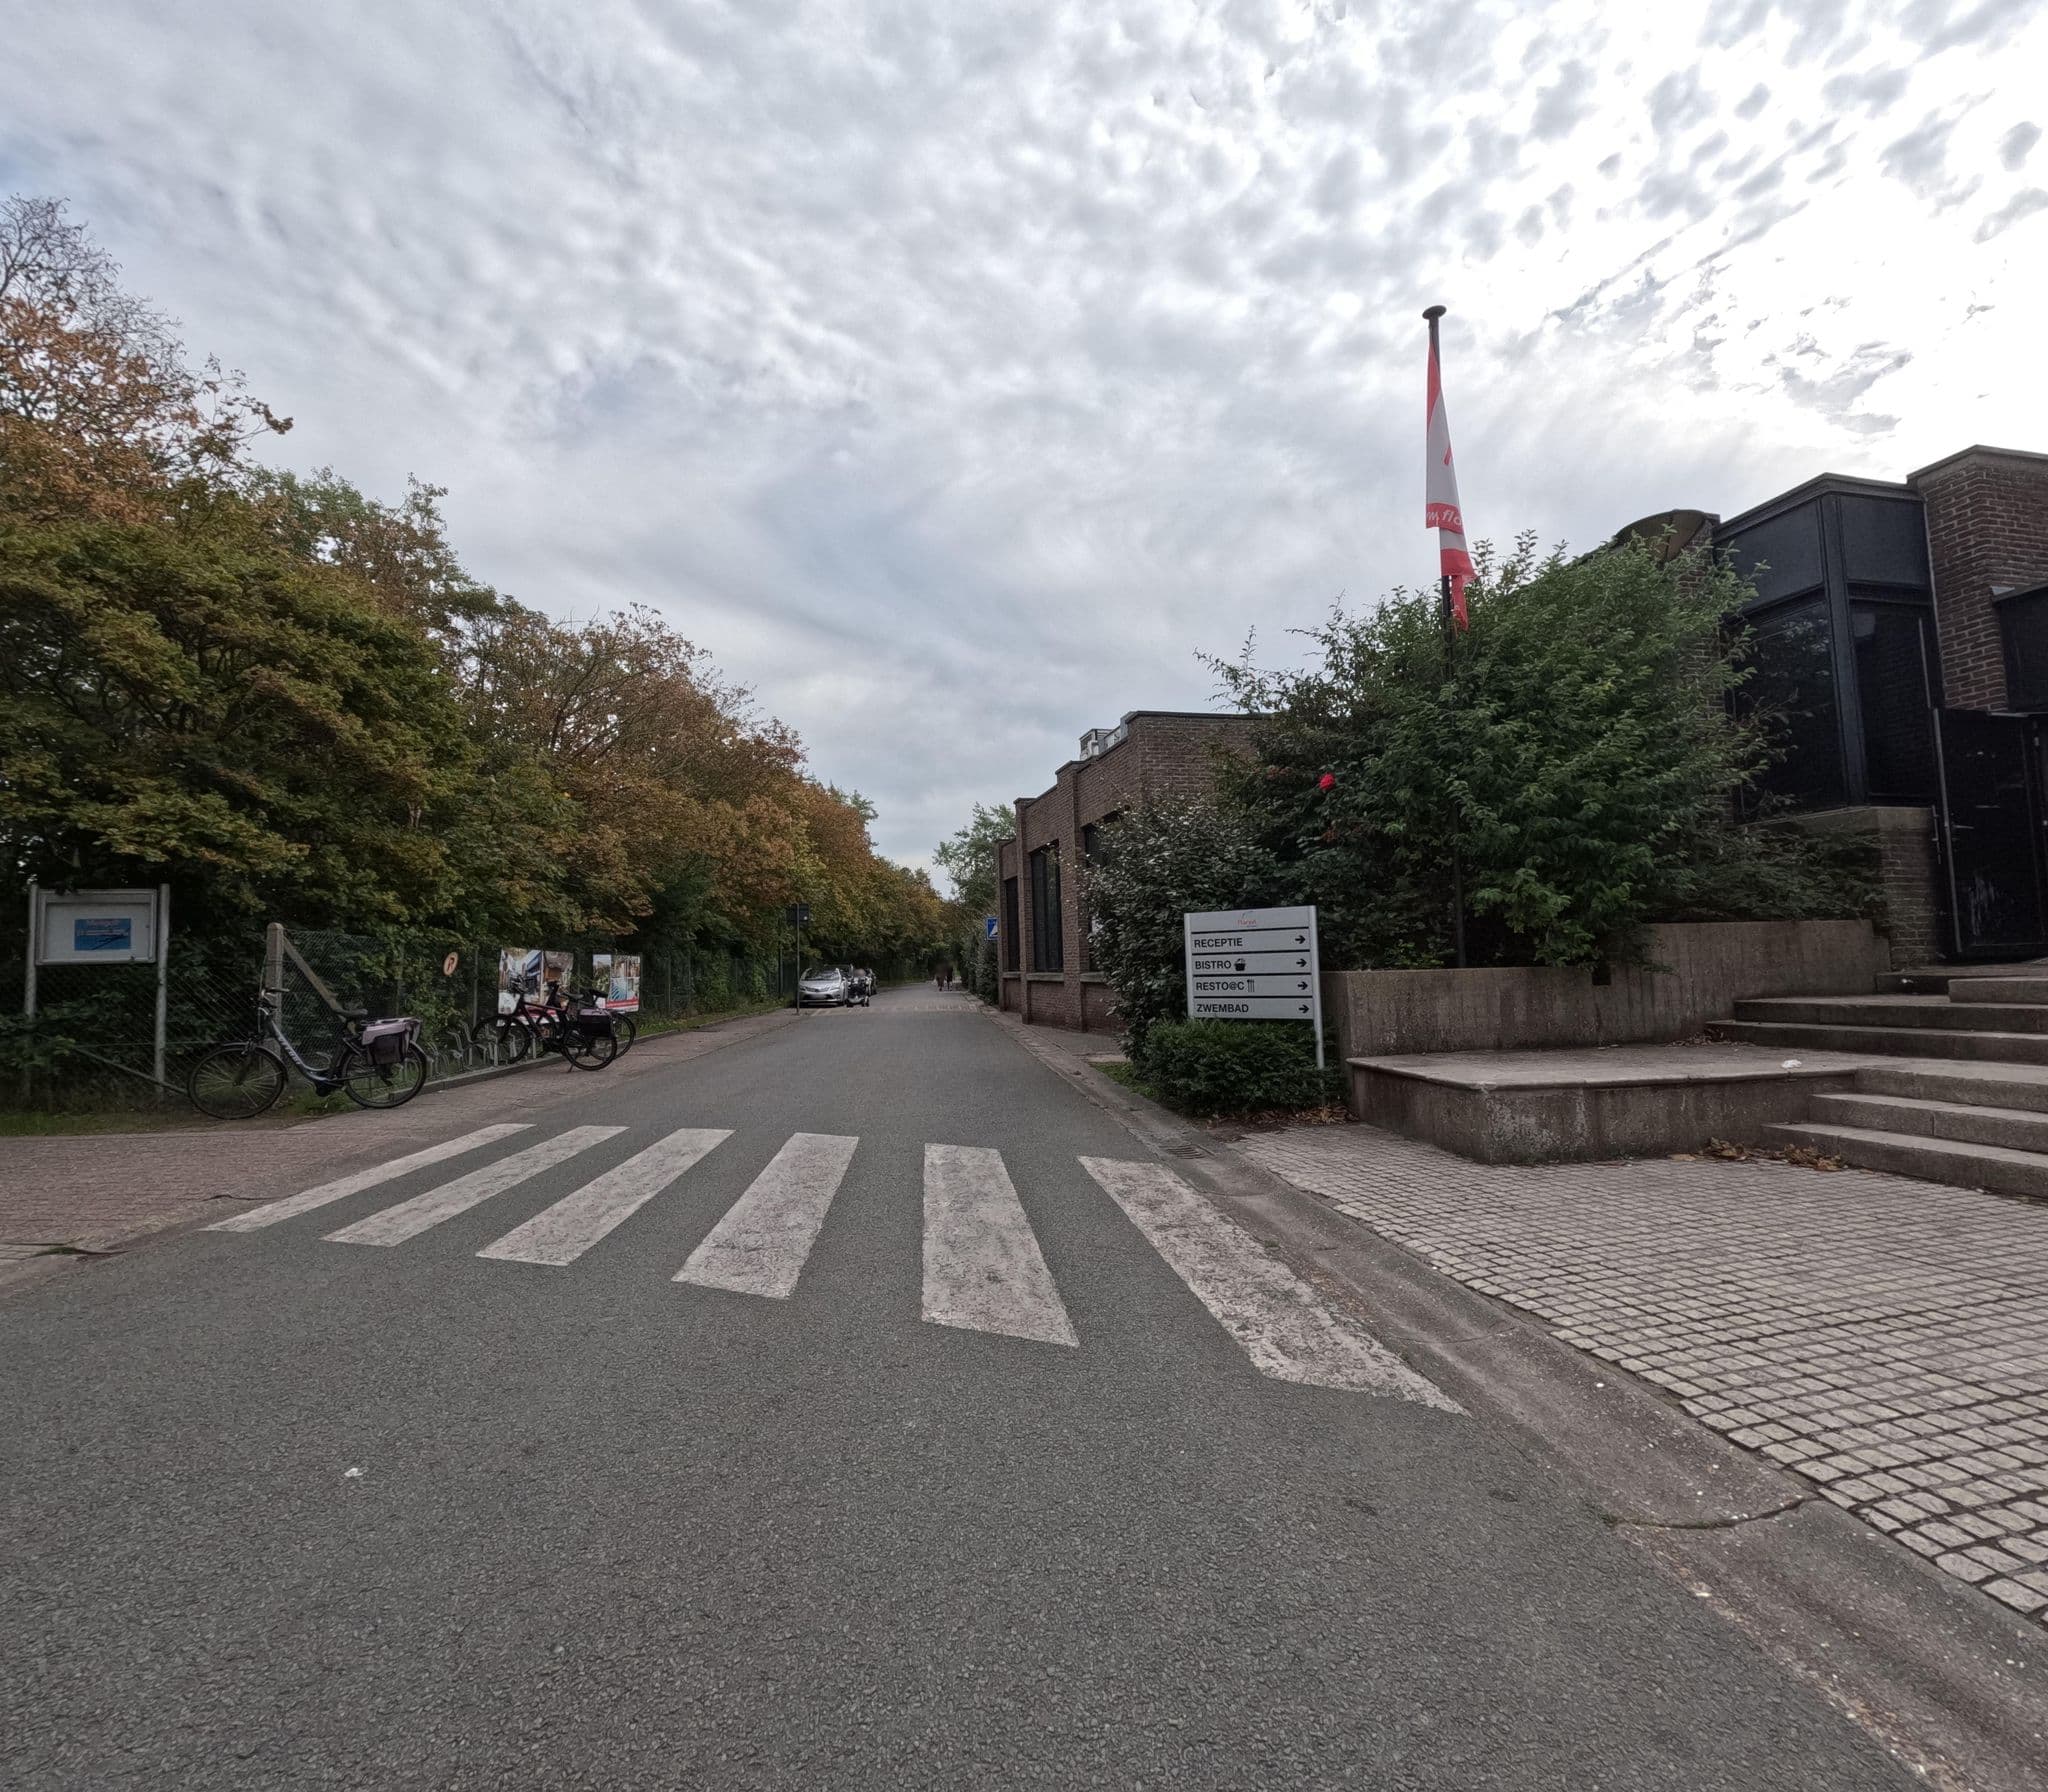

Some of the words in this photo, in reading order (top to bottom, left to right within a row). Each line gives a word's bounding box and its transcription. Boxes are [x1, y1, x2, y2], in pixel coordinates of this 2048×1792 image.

[1194, 937, 1243, 948] RECEPTIE
[1195, 960, 1232, 970] BISTRO
[1196, 981, 1245, 991] RESTO@C
[1196, 1003, 1249, 1013] ZWEMBAD
